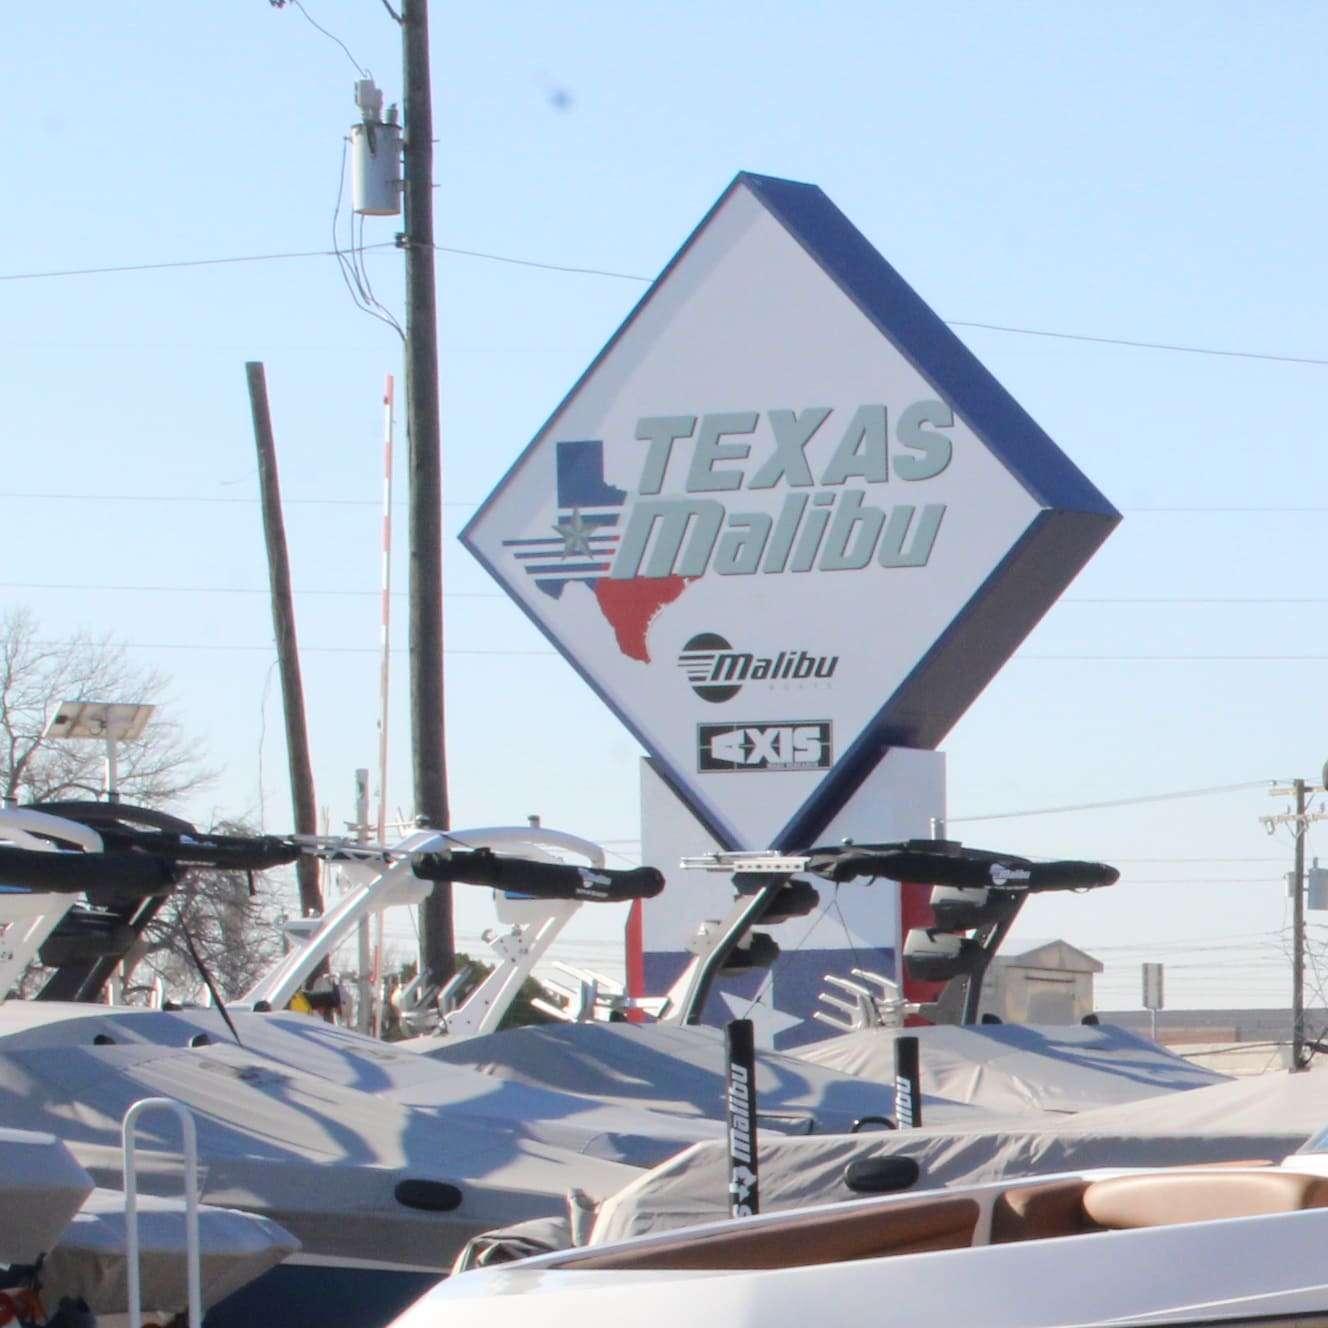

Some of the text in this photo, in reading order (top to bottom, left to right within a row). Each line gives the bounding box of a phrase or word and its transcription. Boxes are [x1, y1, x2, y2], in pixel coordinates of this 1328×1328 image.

[635, 400, 955, 495] TEXAS
[609, 489, 948, 580] Malibu
[710, 651, 839, 681] Malibu
[711, 726, 822, 764] AXIS
[730, 1063, 751, 1163] Malibu
